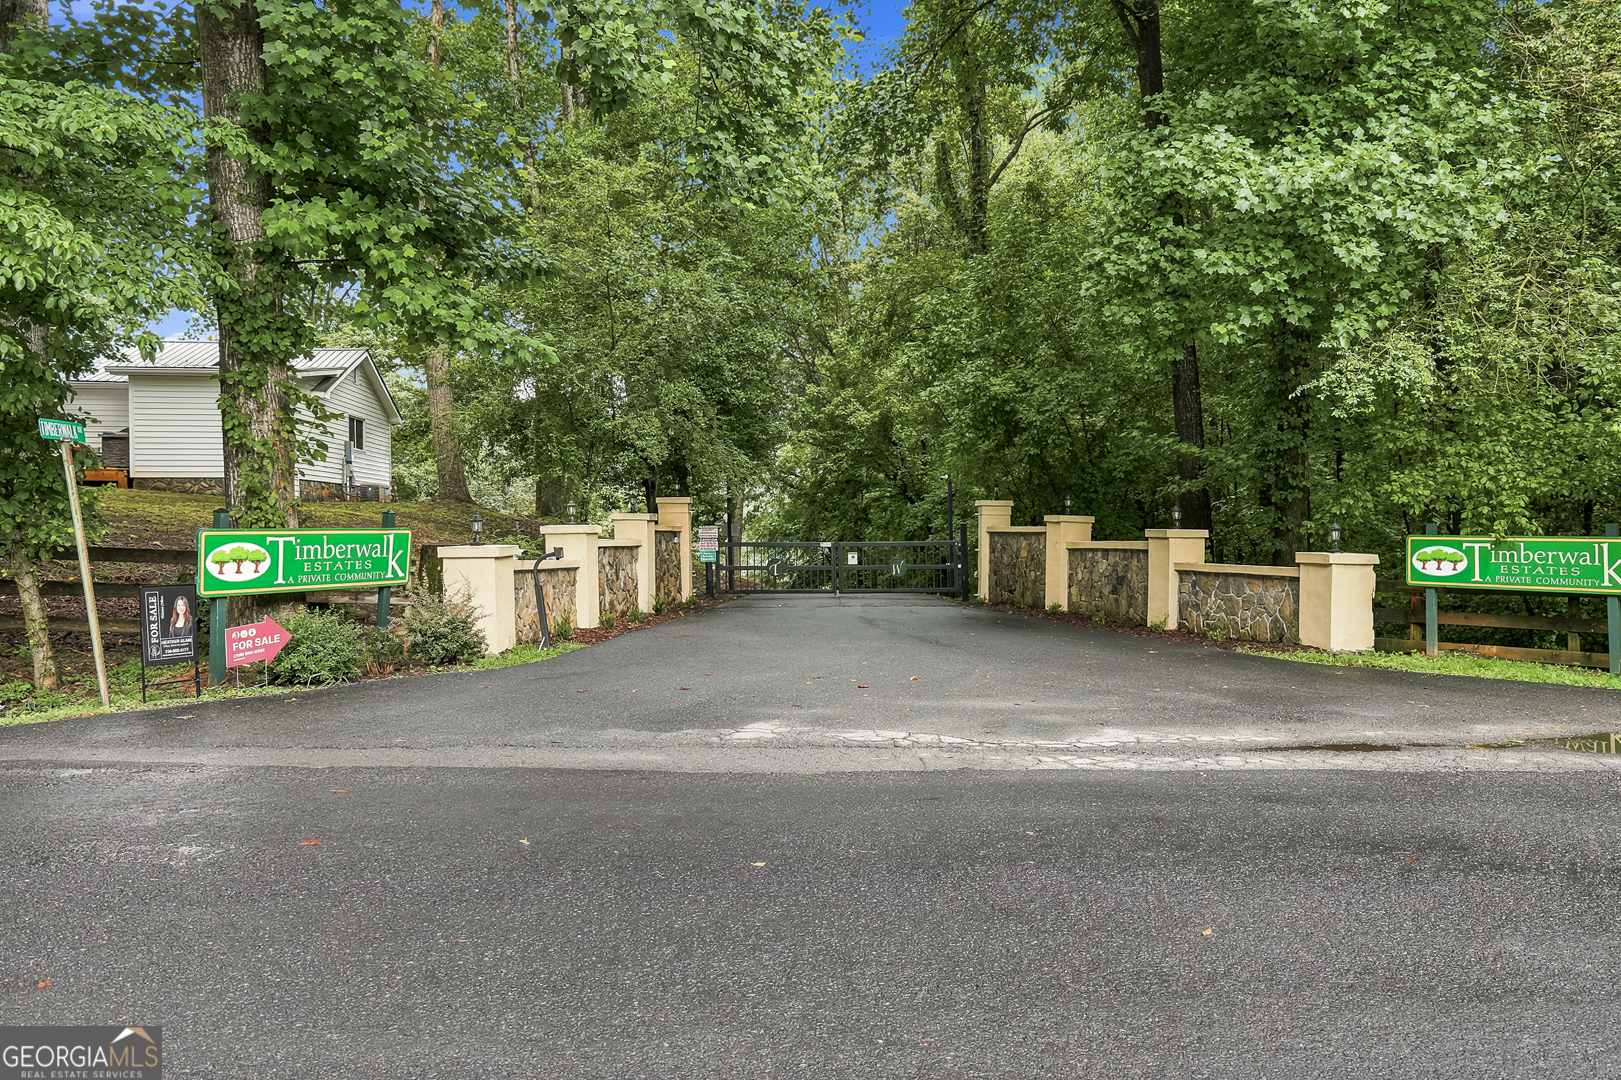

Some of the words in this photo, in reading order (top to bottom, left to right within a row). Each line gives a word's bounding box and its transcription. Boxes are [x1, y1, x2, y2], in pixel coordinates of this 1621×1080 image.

[40, 421, 79, 439] TIMBERWALK
[266, 534, 405, 584] Timberwalk
[304, 559, 372, 572] ESTATES
[1462, 542, 1621, 587] Timberwalk
[287, 576, 294, 584] A
[298, 573, 331, 584] PRIVATE
[334, 571, 386, 582] COMMUNITY
[1500, 565, 1580, 576] ESTATES
[1485, 575, 1492, 583] A
[1495, 576, 1531, 584] PRIVATE
[1536, 577, 1600, 586] COMMUNITY
[148, 596, 158, 621] SALE
[149, 622, 159, 644] FOR
[232, 639, 253, 652] FOR
[254, 634, 280, 647] SALE
